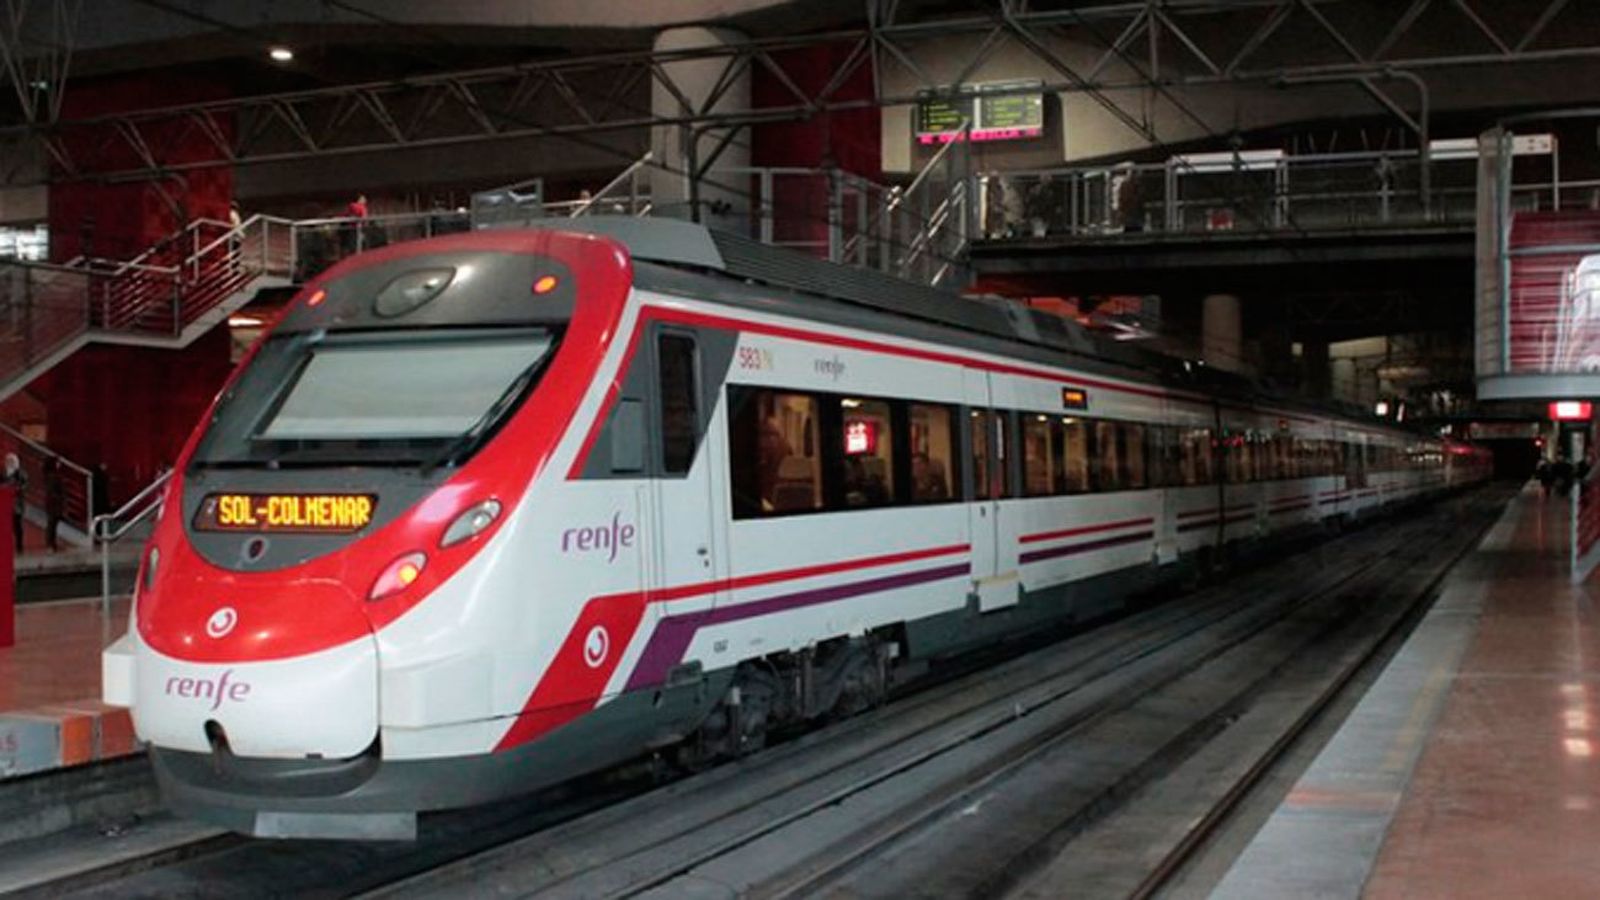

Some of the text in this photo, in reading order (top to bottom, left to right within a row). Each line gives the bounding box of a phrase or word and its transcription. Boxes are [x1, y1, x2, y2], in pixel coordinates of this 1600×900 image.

[219, 495, 371, 526] SOL-COLMENAR
[562, 510, 634, 564] renfe
[165, 669, 251, 711] renfe
